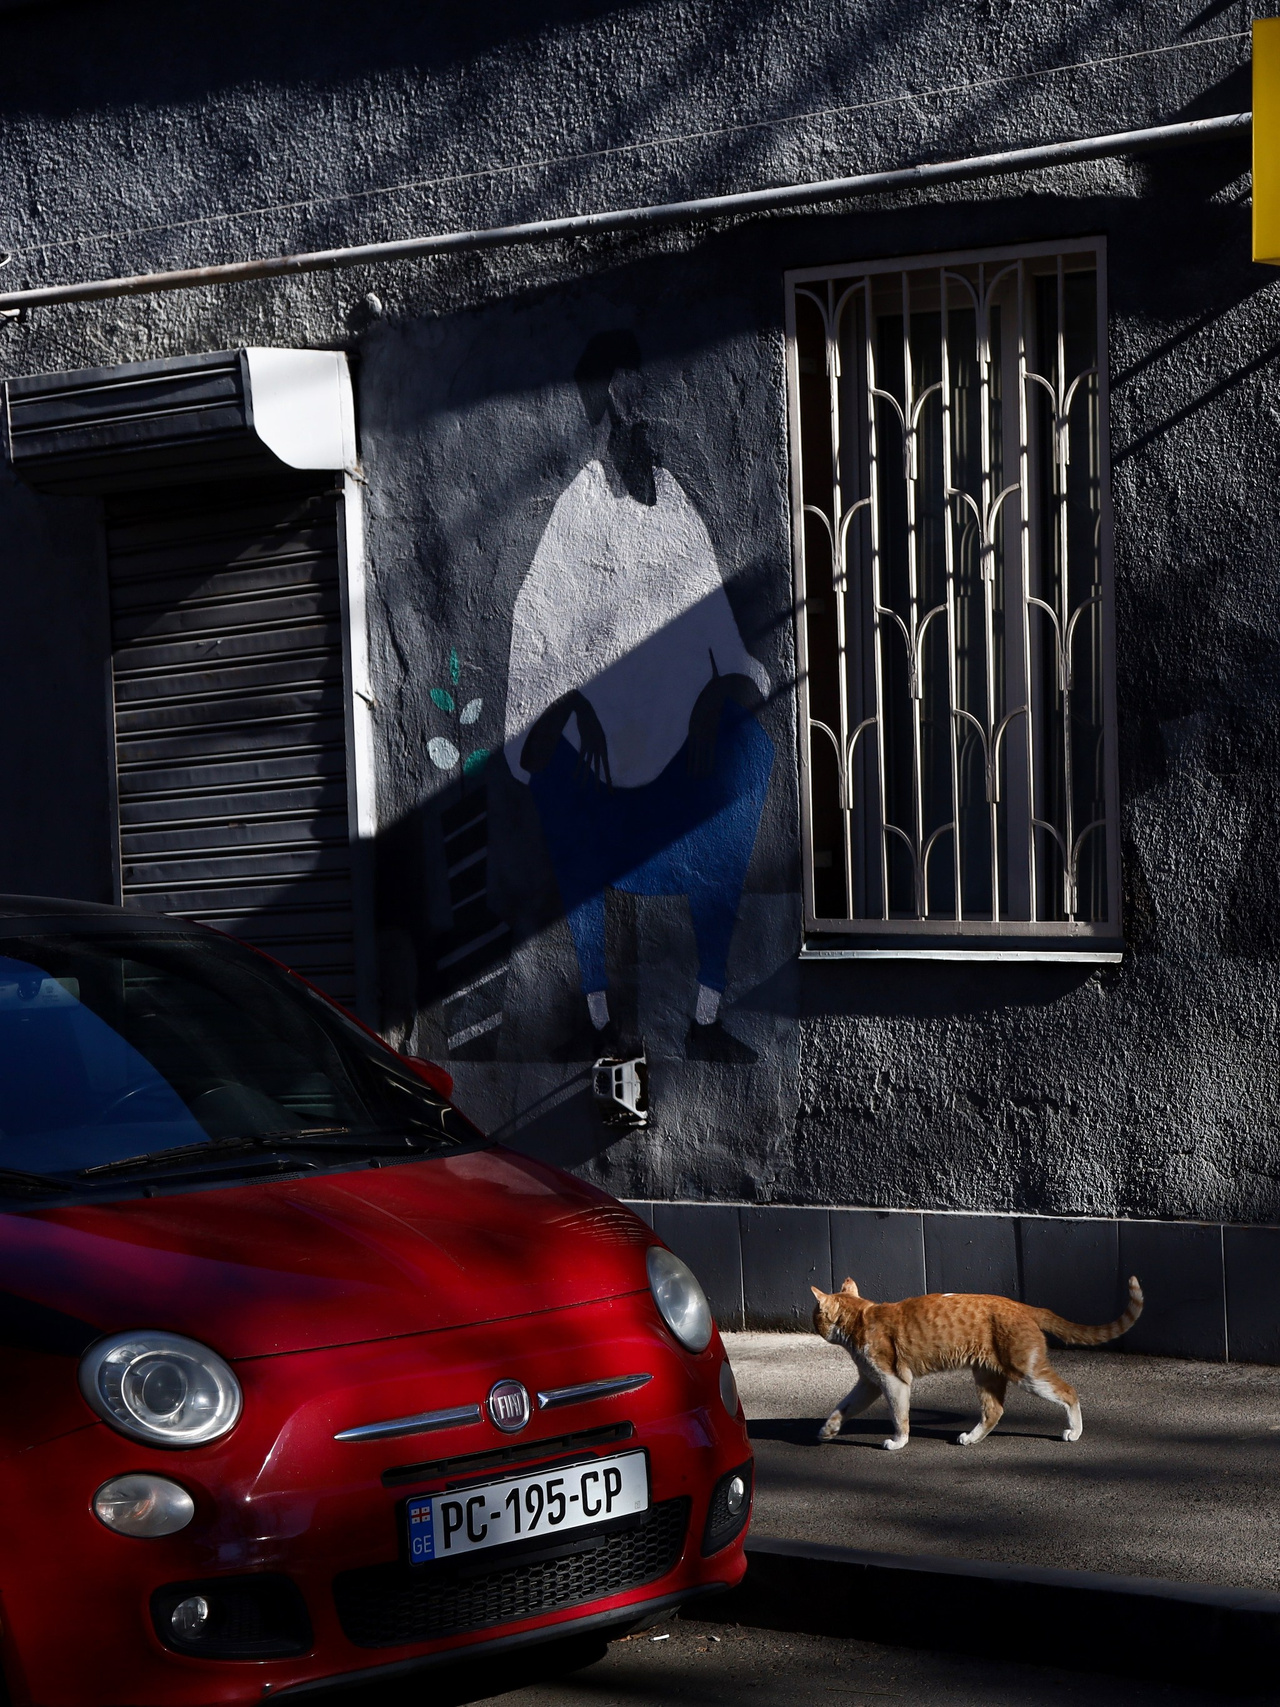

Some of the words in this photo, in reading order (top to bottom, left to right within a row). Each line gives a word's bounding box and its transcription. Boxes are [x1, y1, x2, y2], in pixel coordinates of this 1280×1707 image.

[497, 1392, 522, 1420] FIAT
[440, 1467, 622, 1549] PC-195-CP
[412, 1534, 432, 1556] GE
